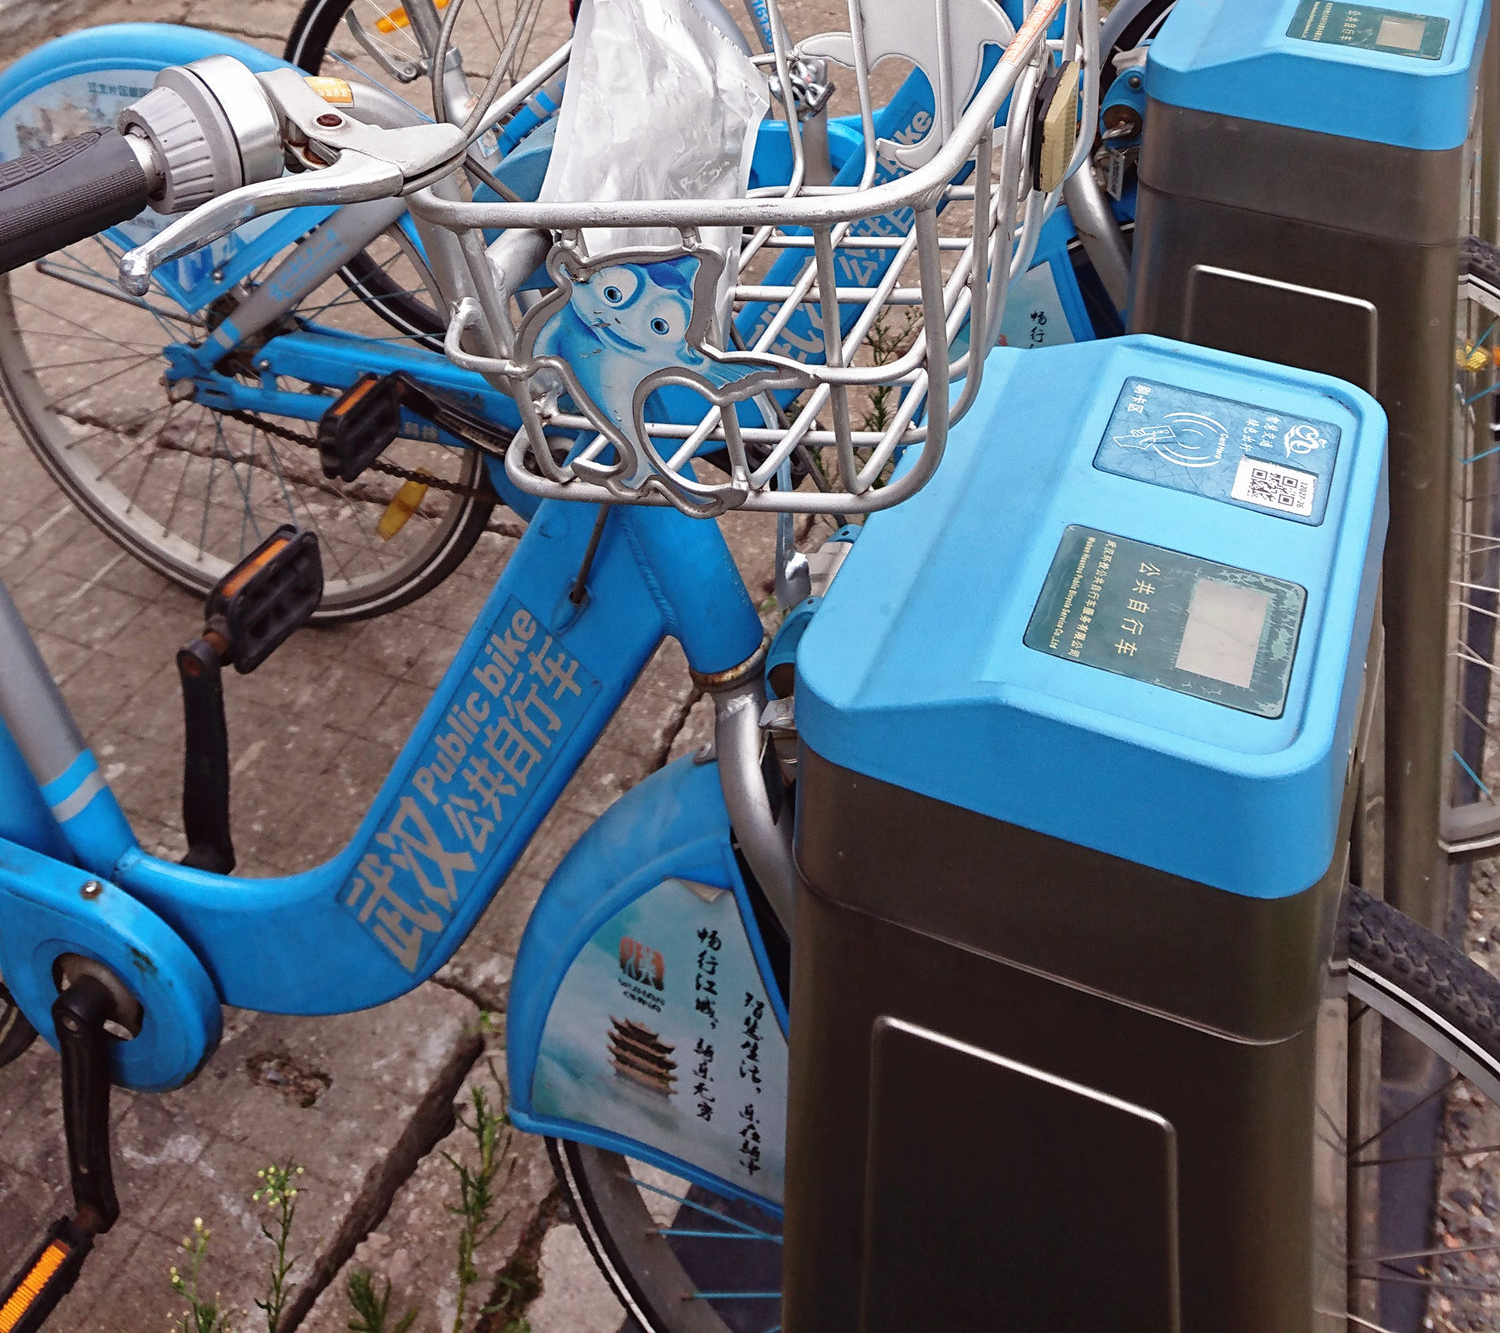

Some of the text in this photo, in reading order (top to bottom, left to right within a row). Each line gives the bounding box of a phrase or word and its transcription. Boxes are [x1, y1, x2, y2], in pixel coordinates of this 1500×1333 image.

[1029, 310, 1047, 349] 畅行
[1127, 384, 1152, 414] 刷卡区
[1259, 416, 1281, 448] 智慧交通
[1239, 418, 1260, 452] 绿色出行
[1114, 562, 1160, 657] 公共自行车
[414, 607, 538, 807] Public bike
[442, 637, 583, 854] 公共自行车
[345, 796, 477, 974] 武汉
